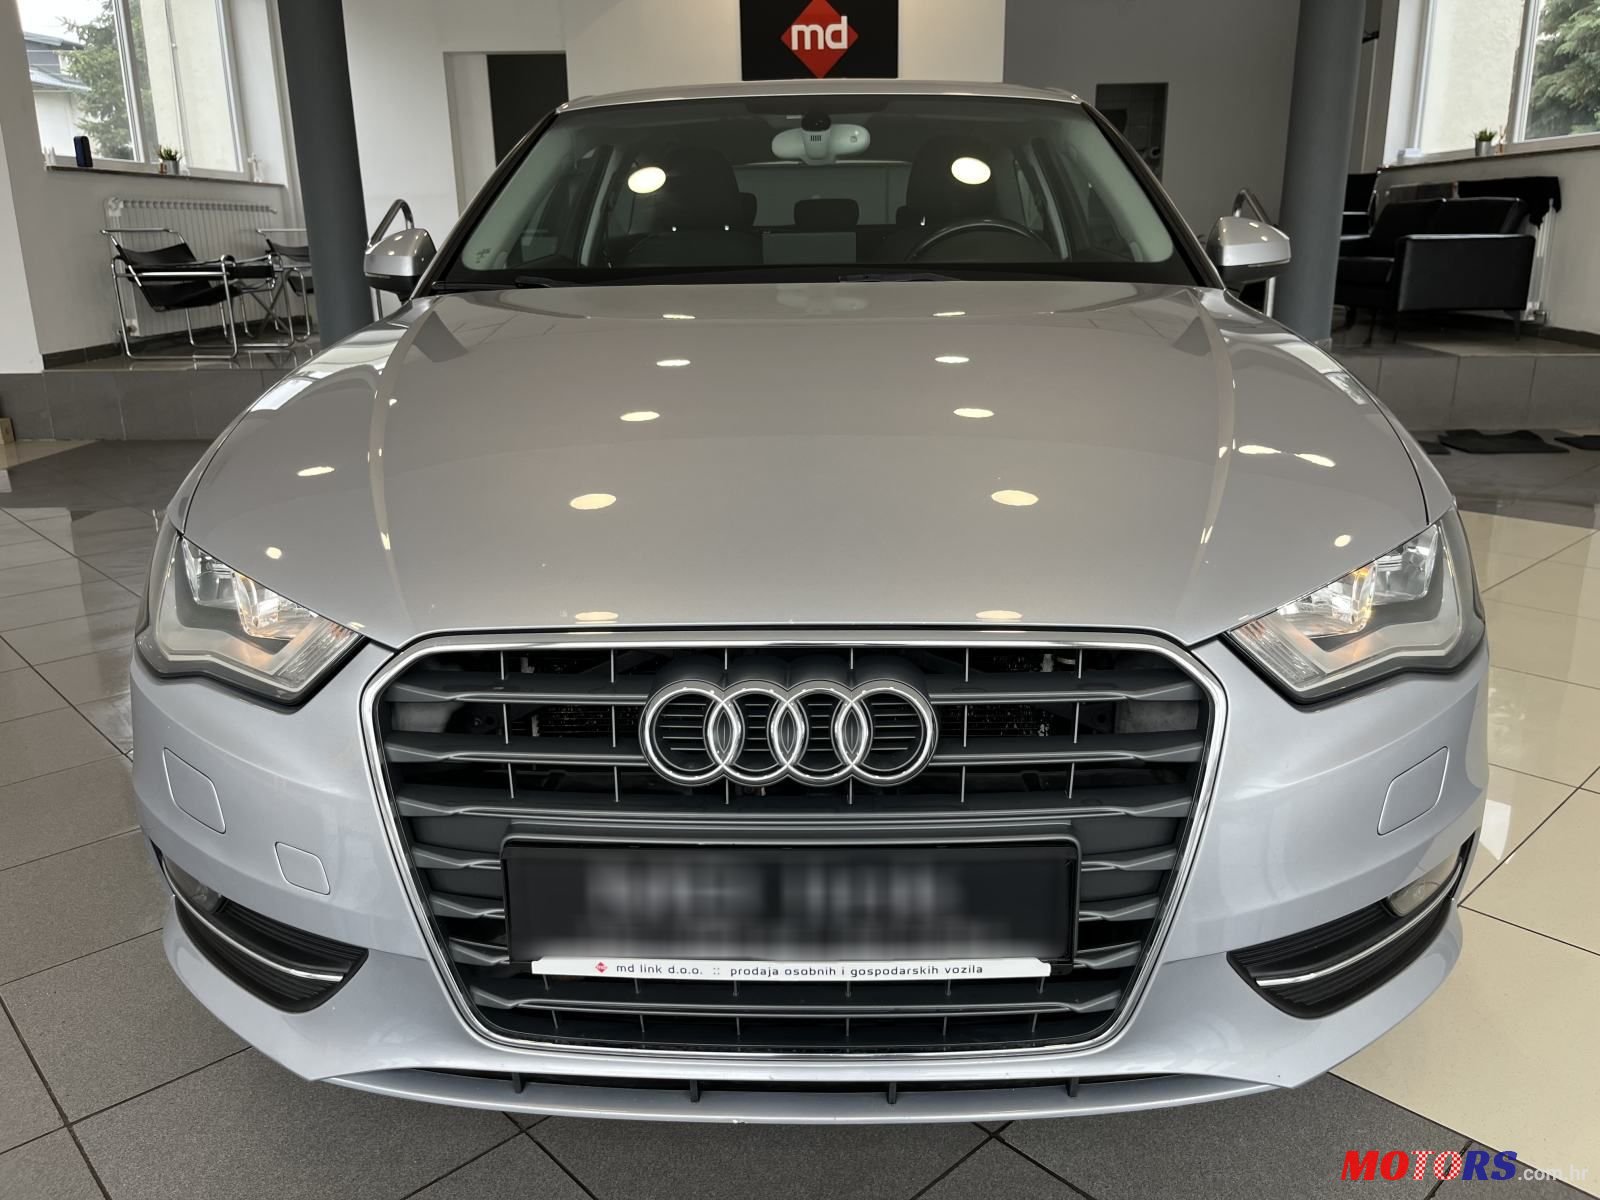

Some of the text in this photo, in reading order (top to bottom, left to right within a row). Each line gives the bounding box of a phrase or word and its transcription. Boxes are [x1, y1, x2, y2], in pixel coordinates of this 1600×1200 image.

[791, 15, 848, 50] md
[616, 963, 635, 973] md
[640, 964, 662, 974] link
[668, 965, 703, 975] d.o.o.
[730, 966, 779, 977] prodaja
[784, 966, 836, 976] osobnih
[850, 965, 938, 978] gospodarskih
[944, 964, 983, 974] vozila
